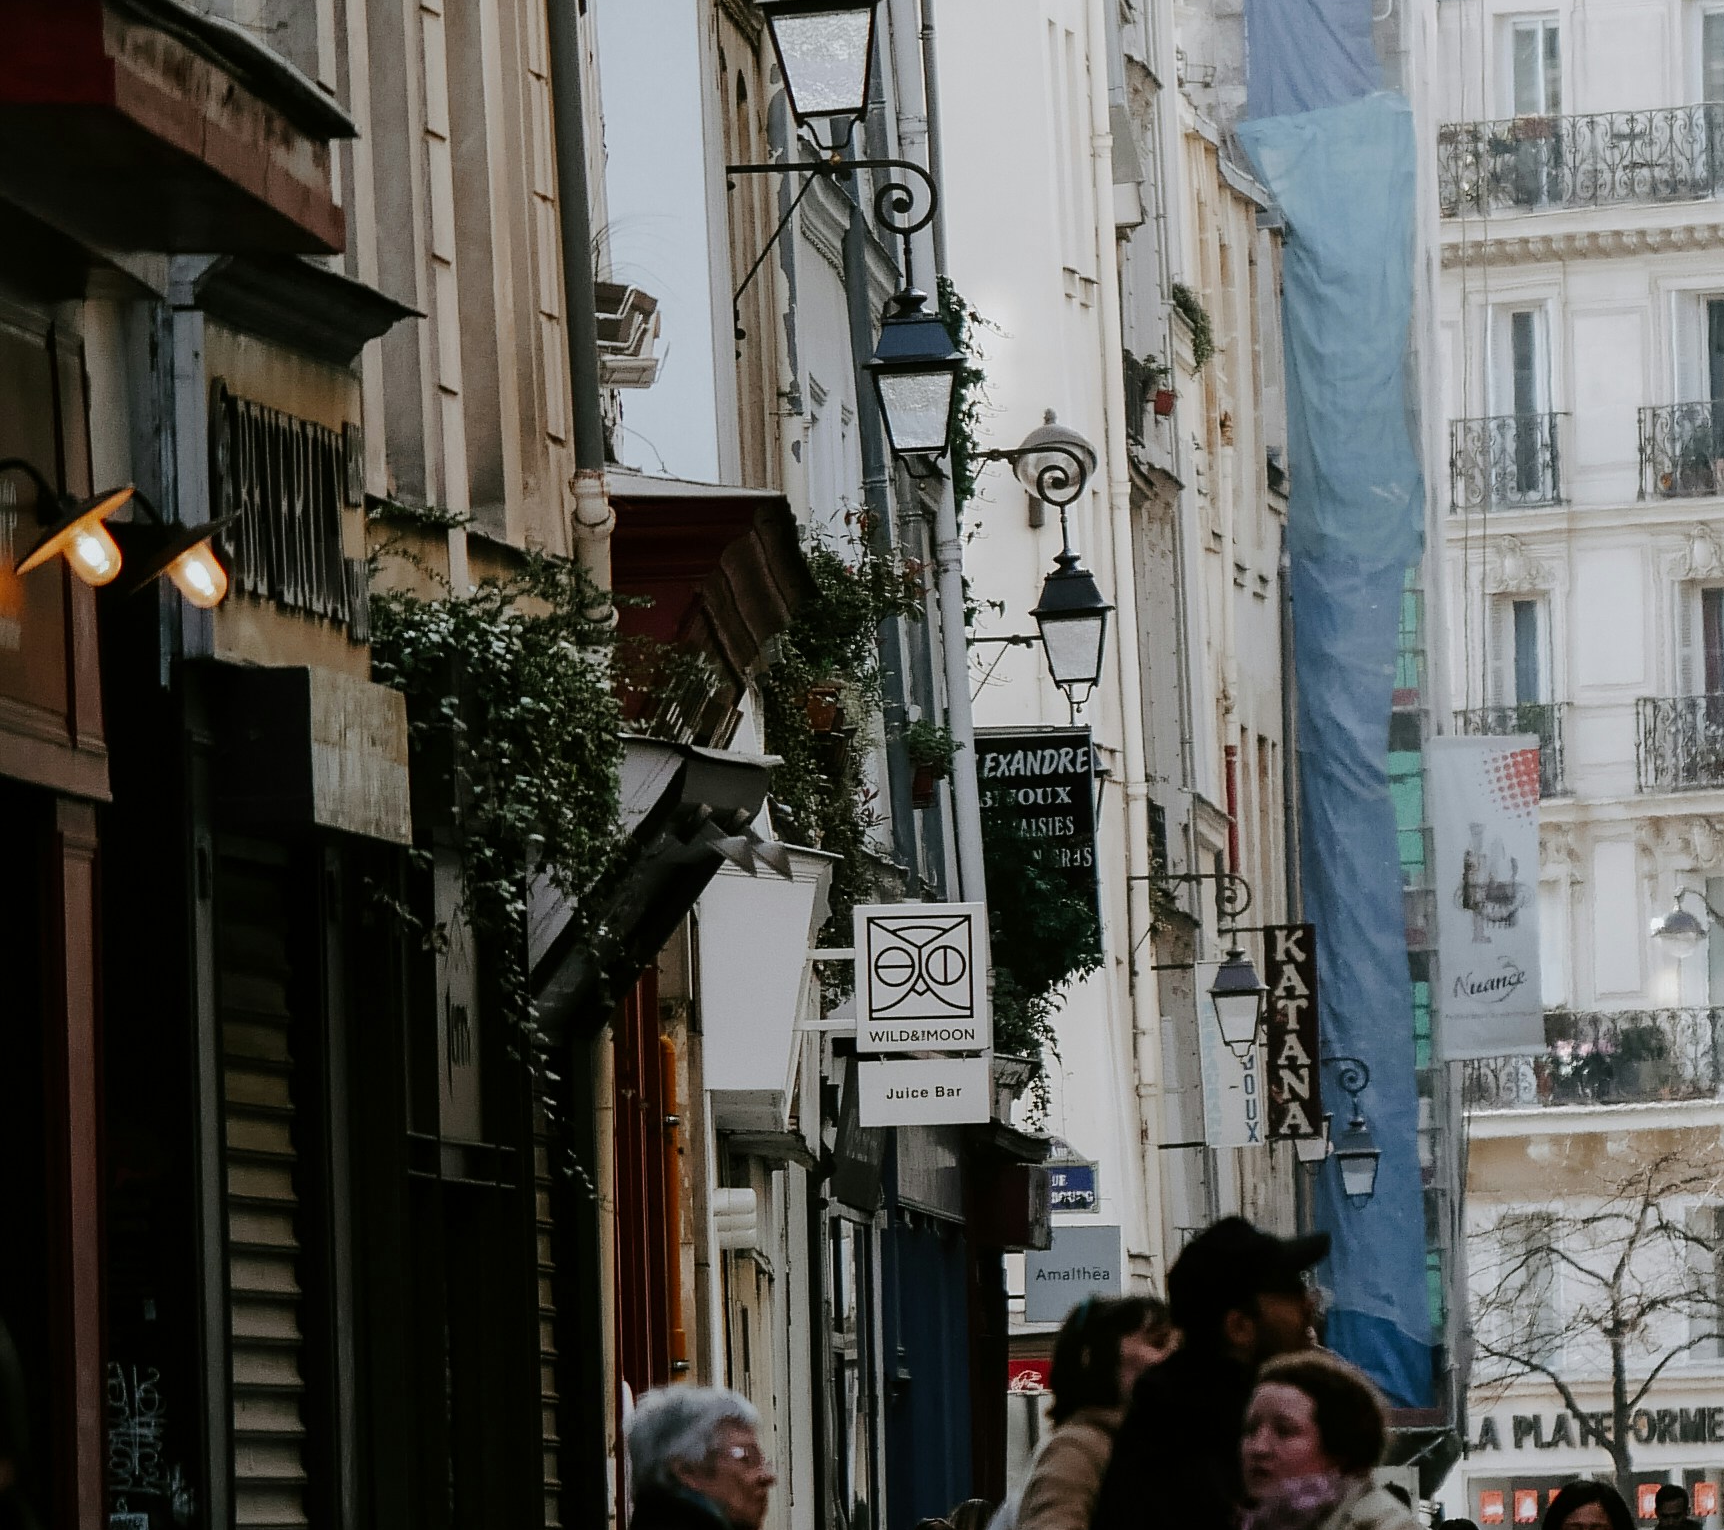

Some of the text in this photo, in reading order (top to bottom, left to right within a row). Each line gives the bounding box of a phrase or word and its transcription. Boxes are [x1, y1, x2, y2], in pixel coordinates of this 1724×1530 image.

[975, 747, 1089, 778] EXANDRE
[1274, 929, 1314, 1134] KATANA
[886, 1085, 962, 1100] Juice Bar
